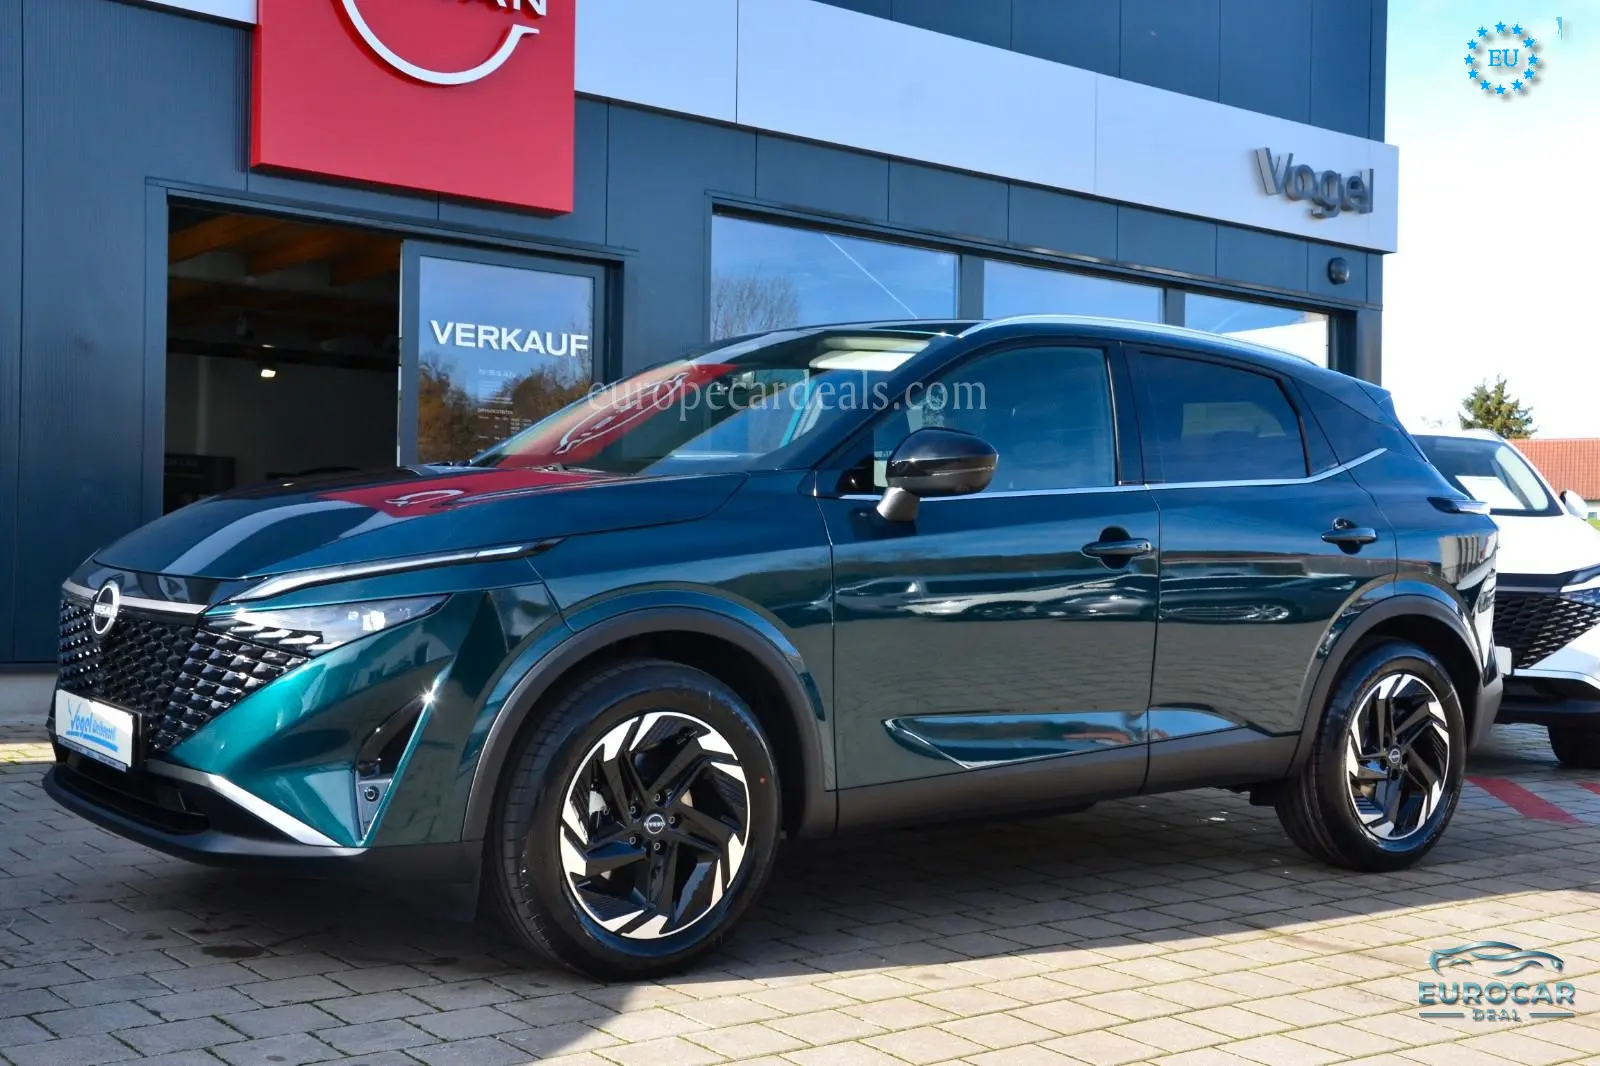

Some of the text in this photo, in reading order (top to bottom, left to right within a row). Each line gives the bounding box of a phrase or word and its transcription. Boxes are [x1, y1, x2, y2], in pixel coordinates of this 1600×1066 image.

[1254, 147, 1374, 219] Vogel
[430, 319, 589, 357] VERKAUF
[67, 697, 93, 737] Vogel
